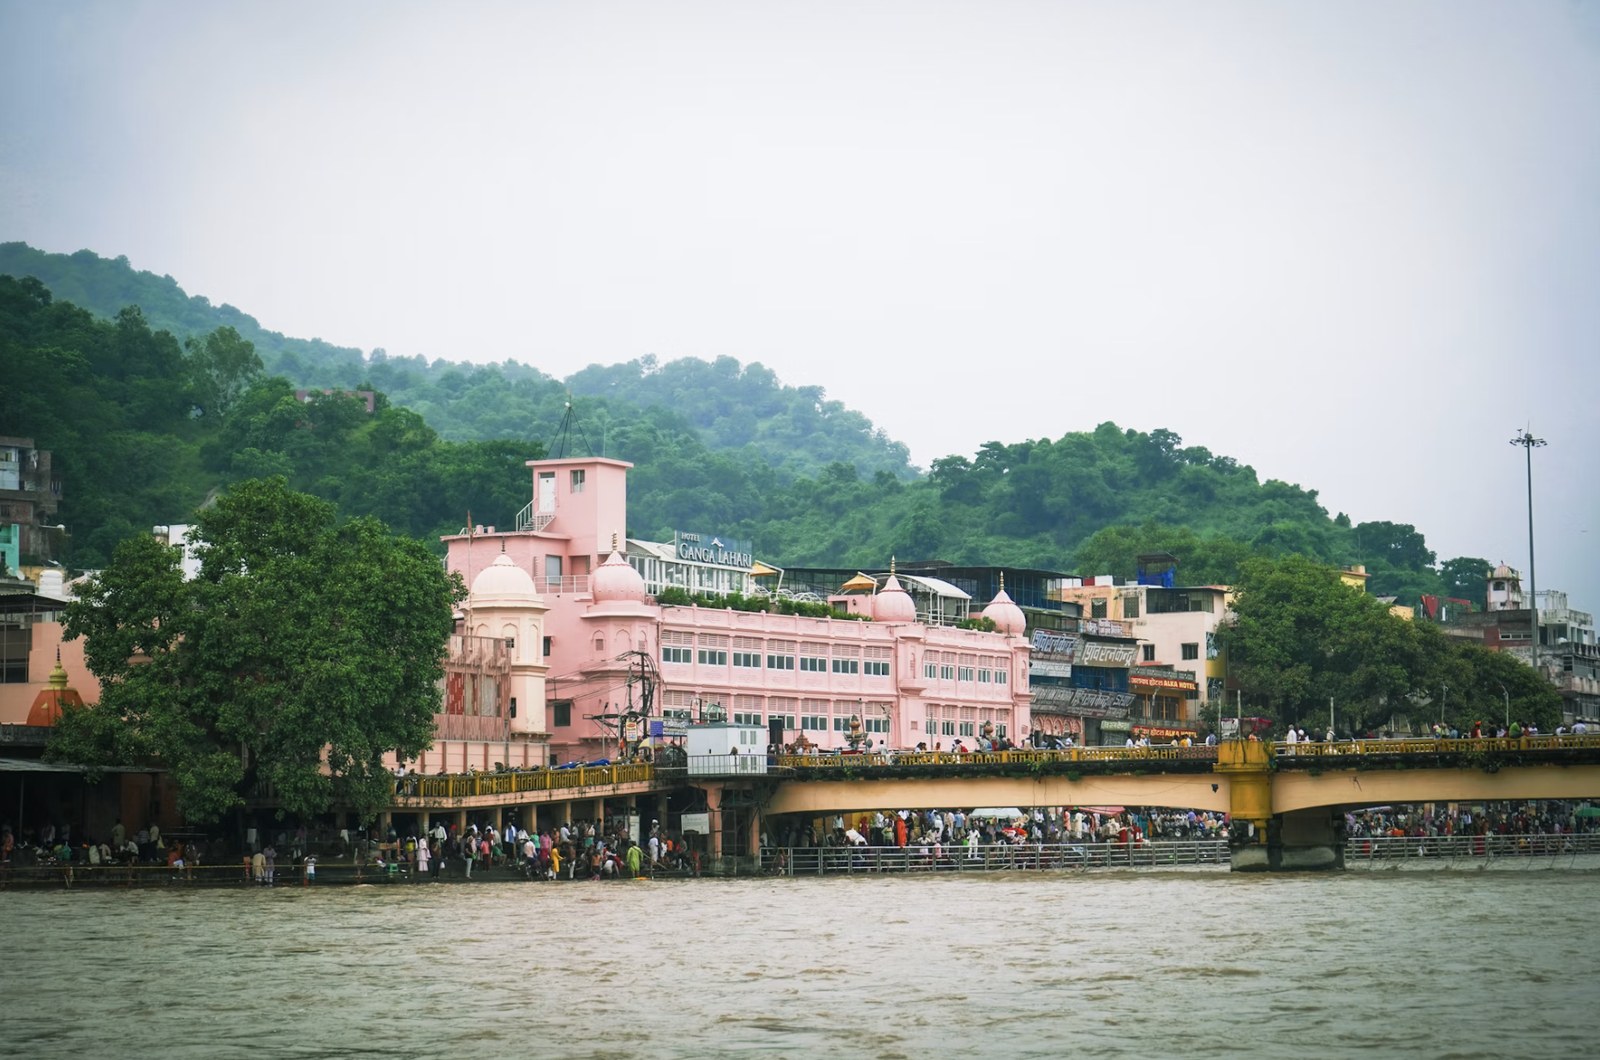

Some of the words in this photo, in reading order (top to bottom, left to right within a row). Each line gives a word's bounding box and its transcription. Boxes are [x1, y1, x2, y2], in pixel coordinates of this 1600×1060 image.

[681, 532, 700, 542] HOTEL
[680, 543, 715, 563] GANGA
[718, 547, 752, 567] LAHARI
[1163, 680, 1178, 688] ALKA
[1179, 681, 1196, 690] HOTEL
[1165, 729, 1179, 737] ALKA
